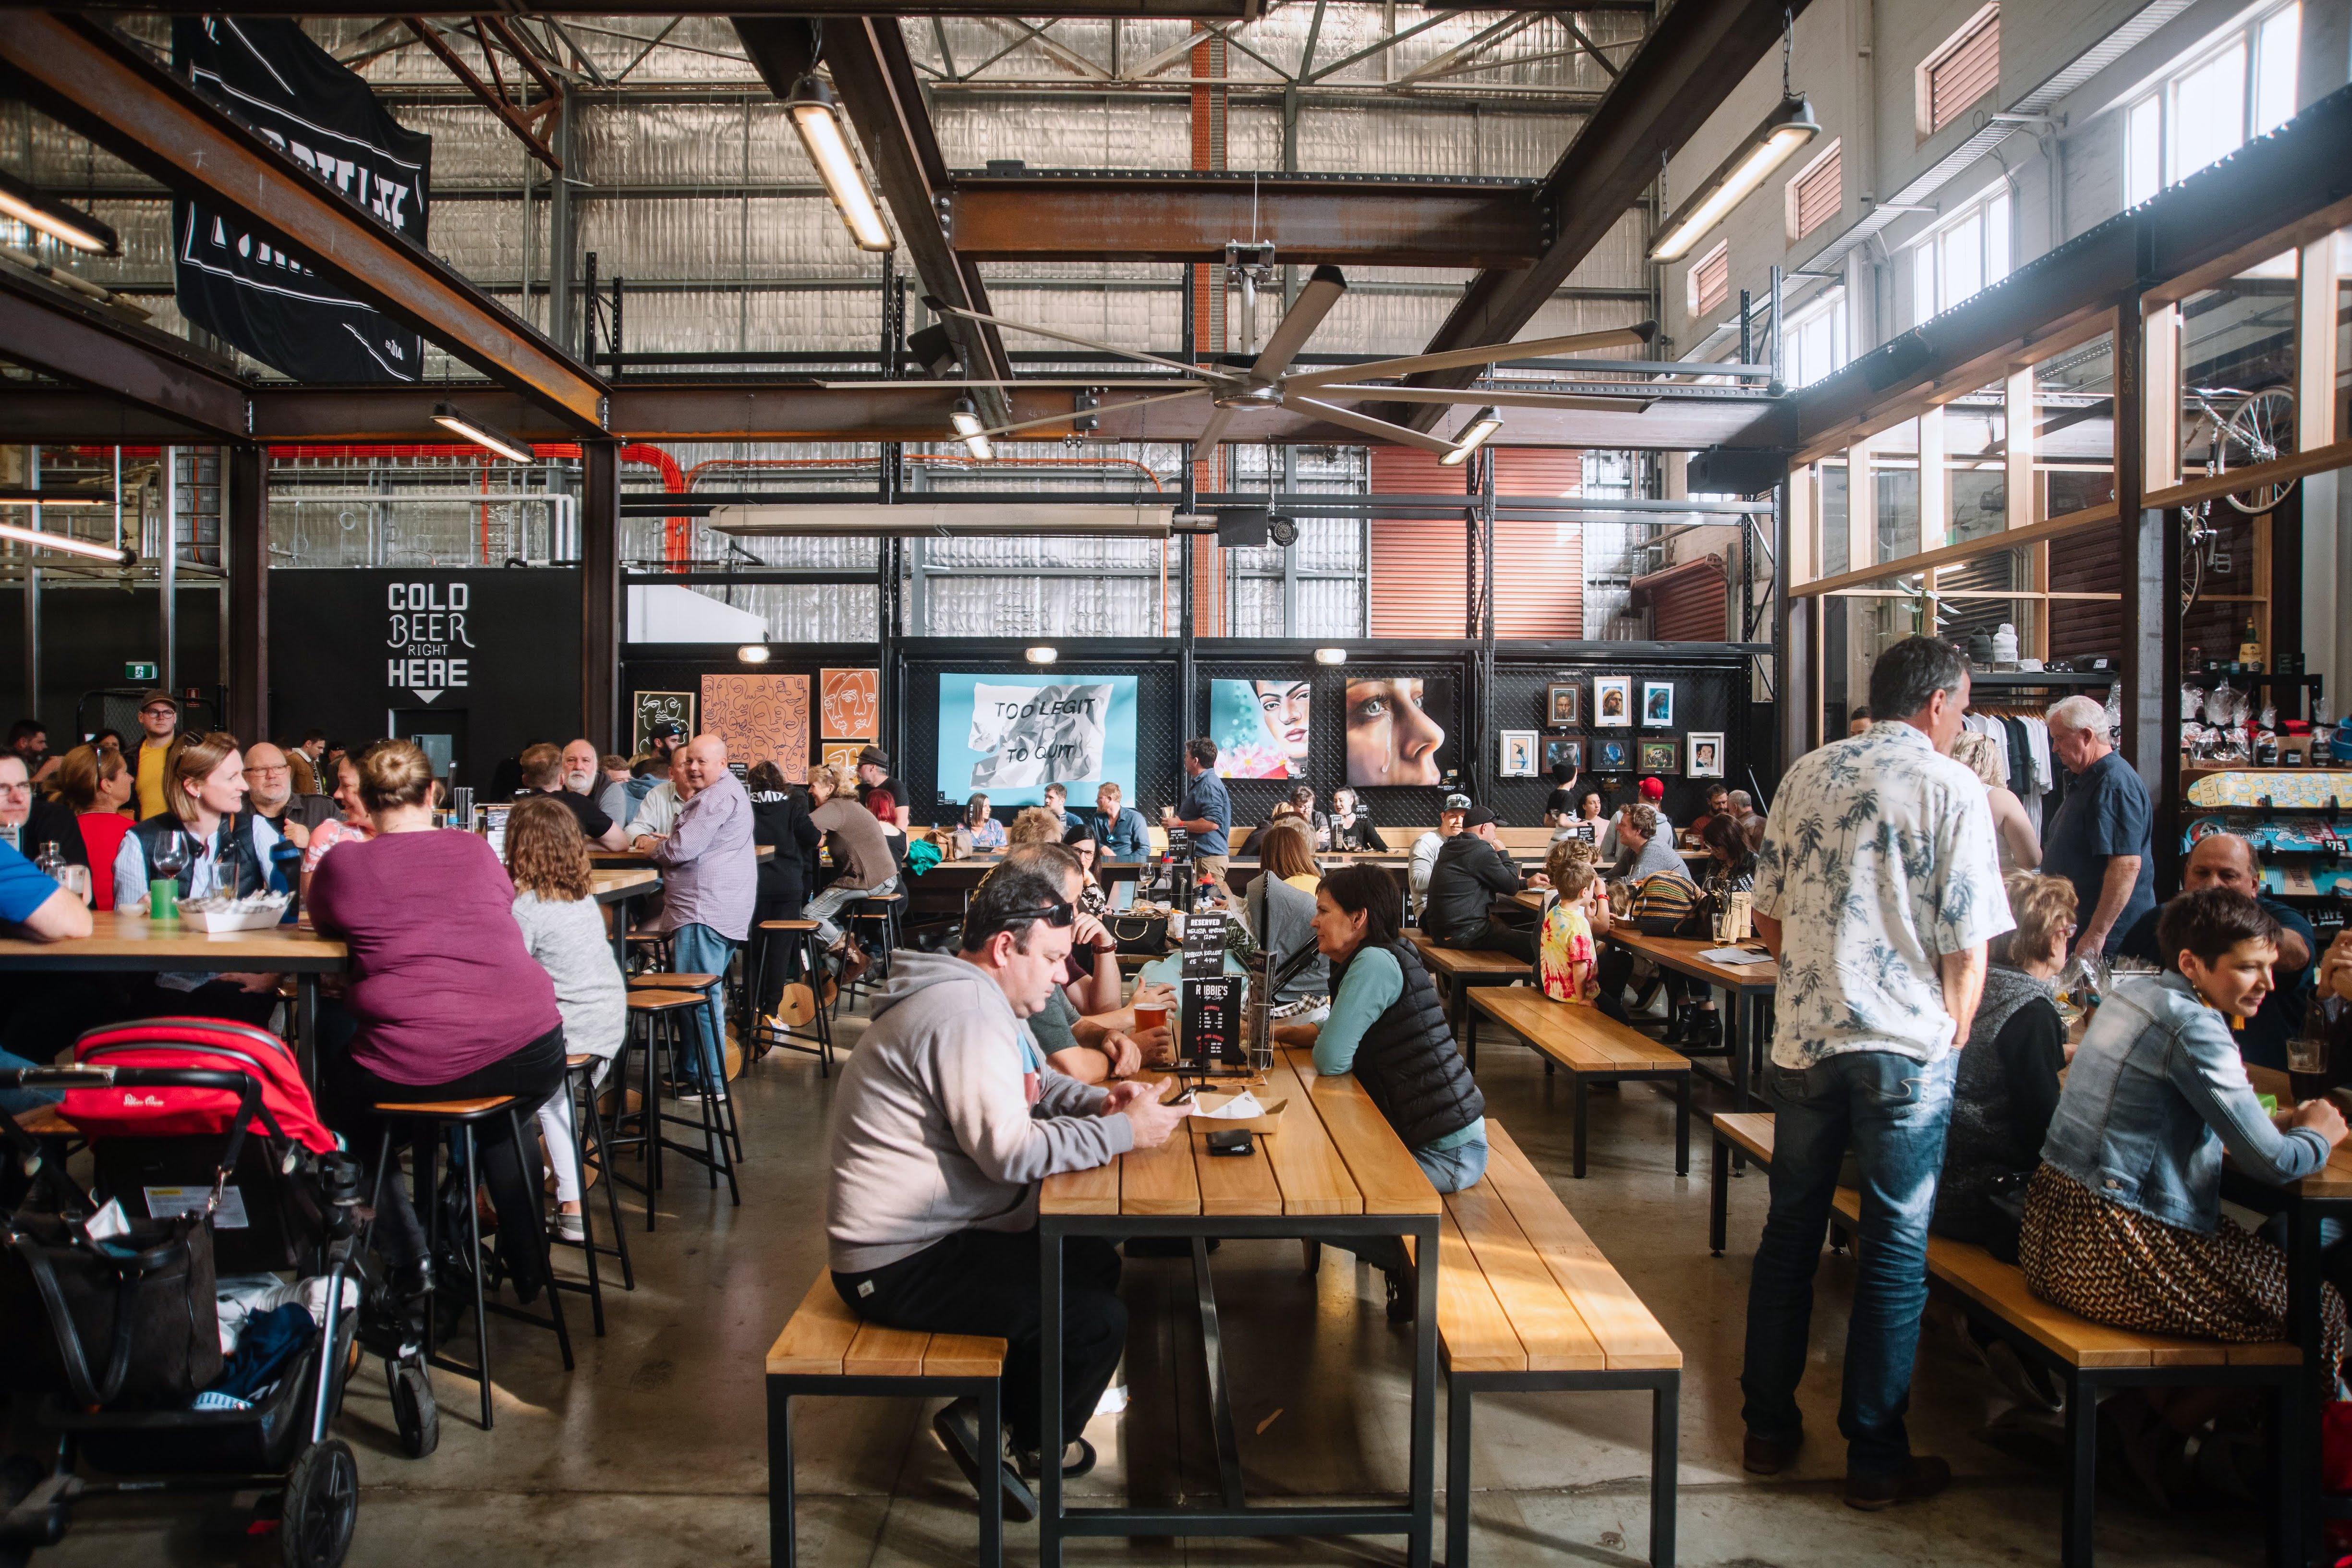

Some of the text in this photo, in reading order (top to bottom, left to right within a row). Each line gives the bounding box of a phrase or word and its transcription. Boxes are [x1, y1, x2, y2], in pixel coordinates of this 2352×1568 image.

[388, 583, 468, 611] COLD
[387, 613, 475, 648] BEER
[408, 644, 448, 656] RIGHT
[388, 659, 468, 687] HERE
[994, 698, 1095, 719] TOO LEGIT
[1007, 744, 1074, 763] TO QUIT
[2326, 840, 2346, 851] $75
[1196, 984, 1228, 996] RBBIE'S
